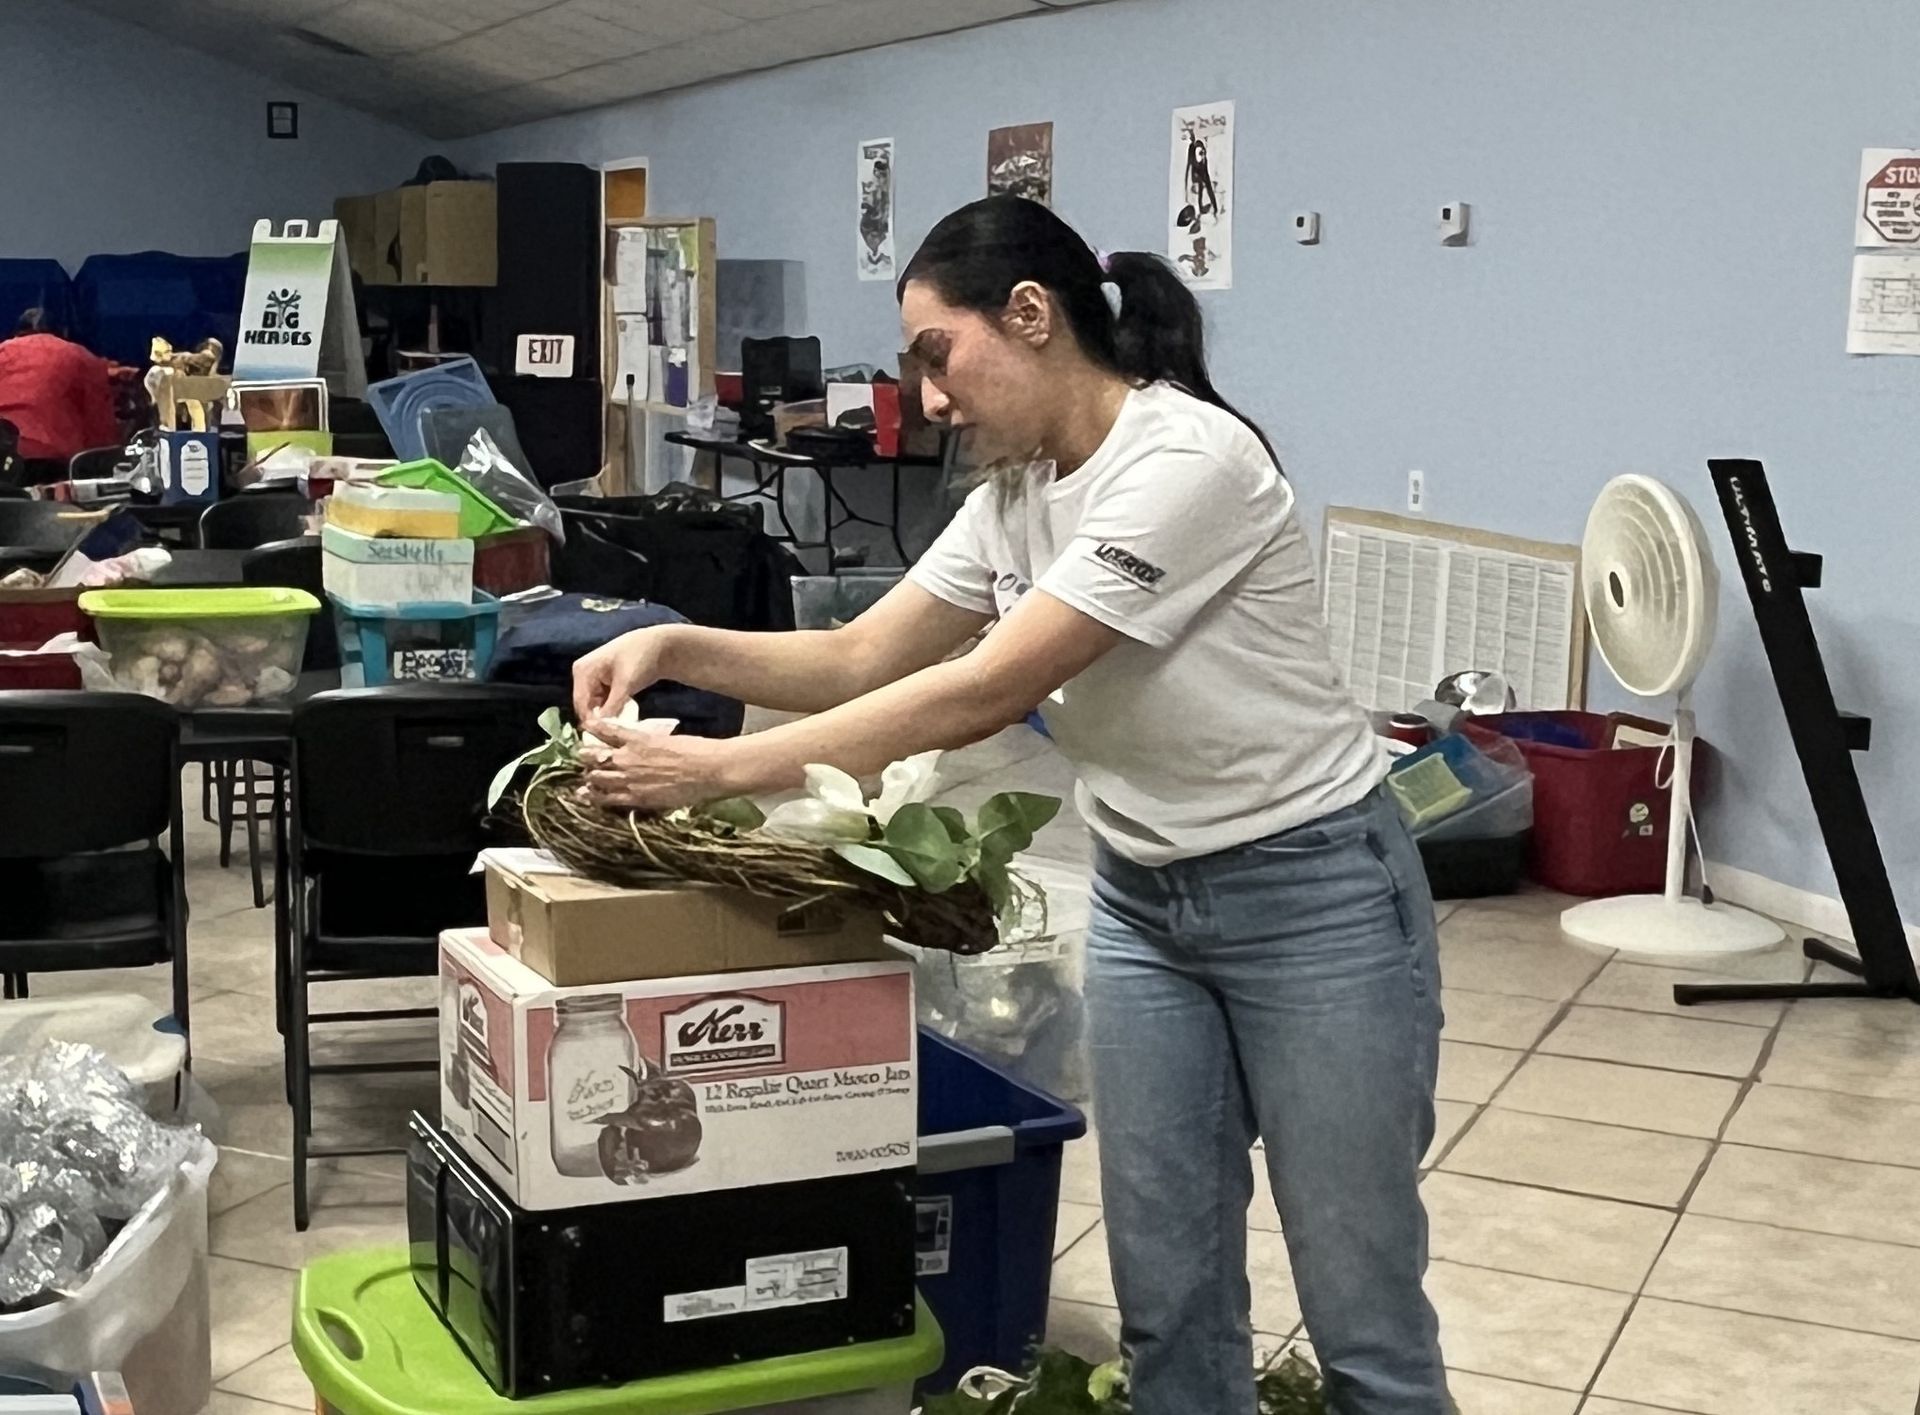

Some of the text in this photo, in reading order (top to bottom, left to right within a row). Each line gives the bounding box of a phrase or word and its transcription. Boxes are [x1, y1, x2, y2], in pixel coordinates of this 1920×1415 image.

[1884, 166, 1920, 184] STO
[529, 338, 564, 364] EXIT
[678, 1004, 763, 1047] Kerr
